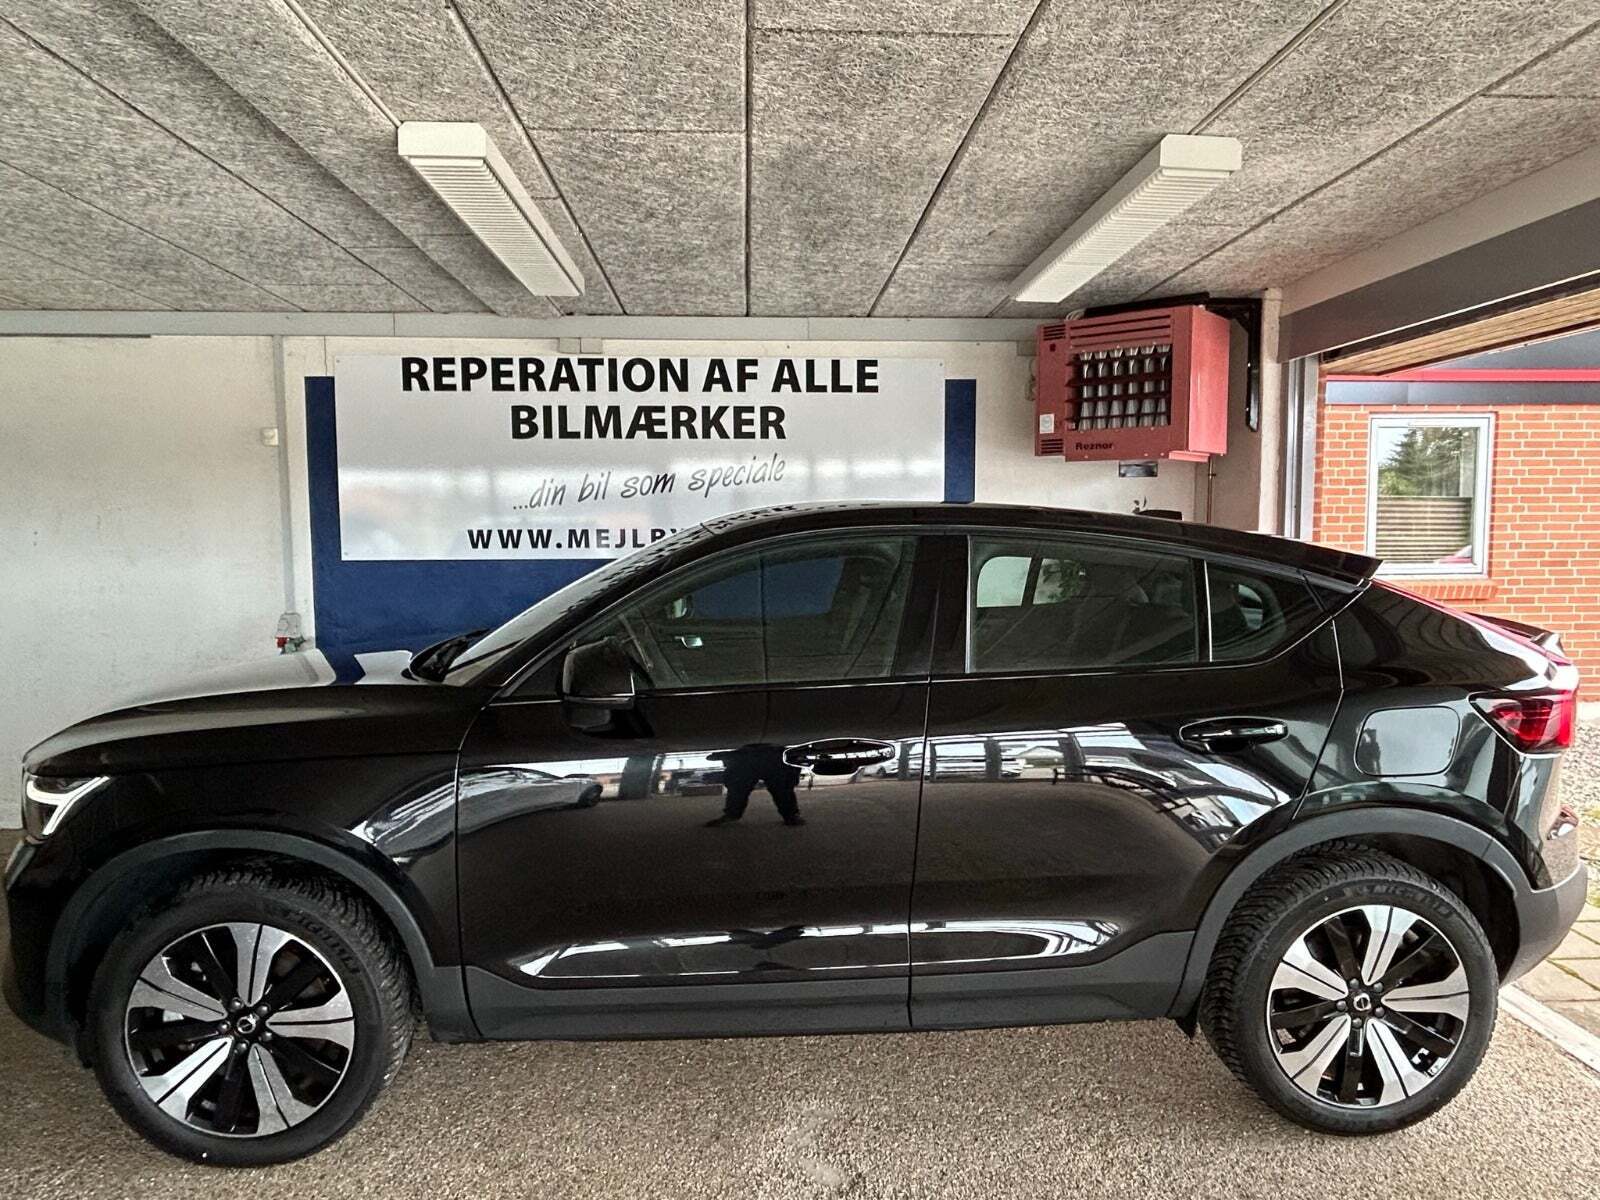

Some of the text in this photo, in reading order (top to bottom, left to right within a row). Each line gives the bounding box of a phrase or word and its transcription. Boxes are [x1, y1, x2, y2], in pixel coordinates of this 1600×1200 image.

[401, 356, 879, 393] REPERATION AF ALLE
[510, 404, 787, 440] BILMÆRKER
[577, 471, 612, 503] bil
[620, 472, 677, 499] som
[687, 452, 786, 499] speciale
[467, 528, 685, 550] WWW.MEJL
